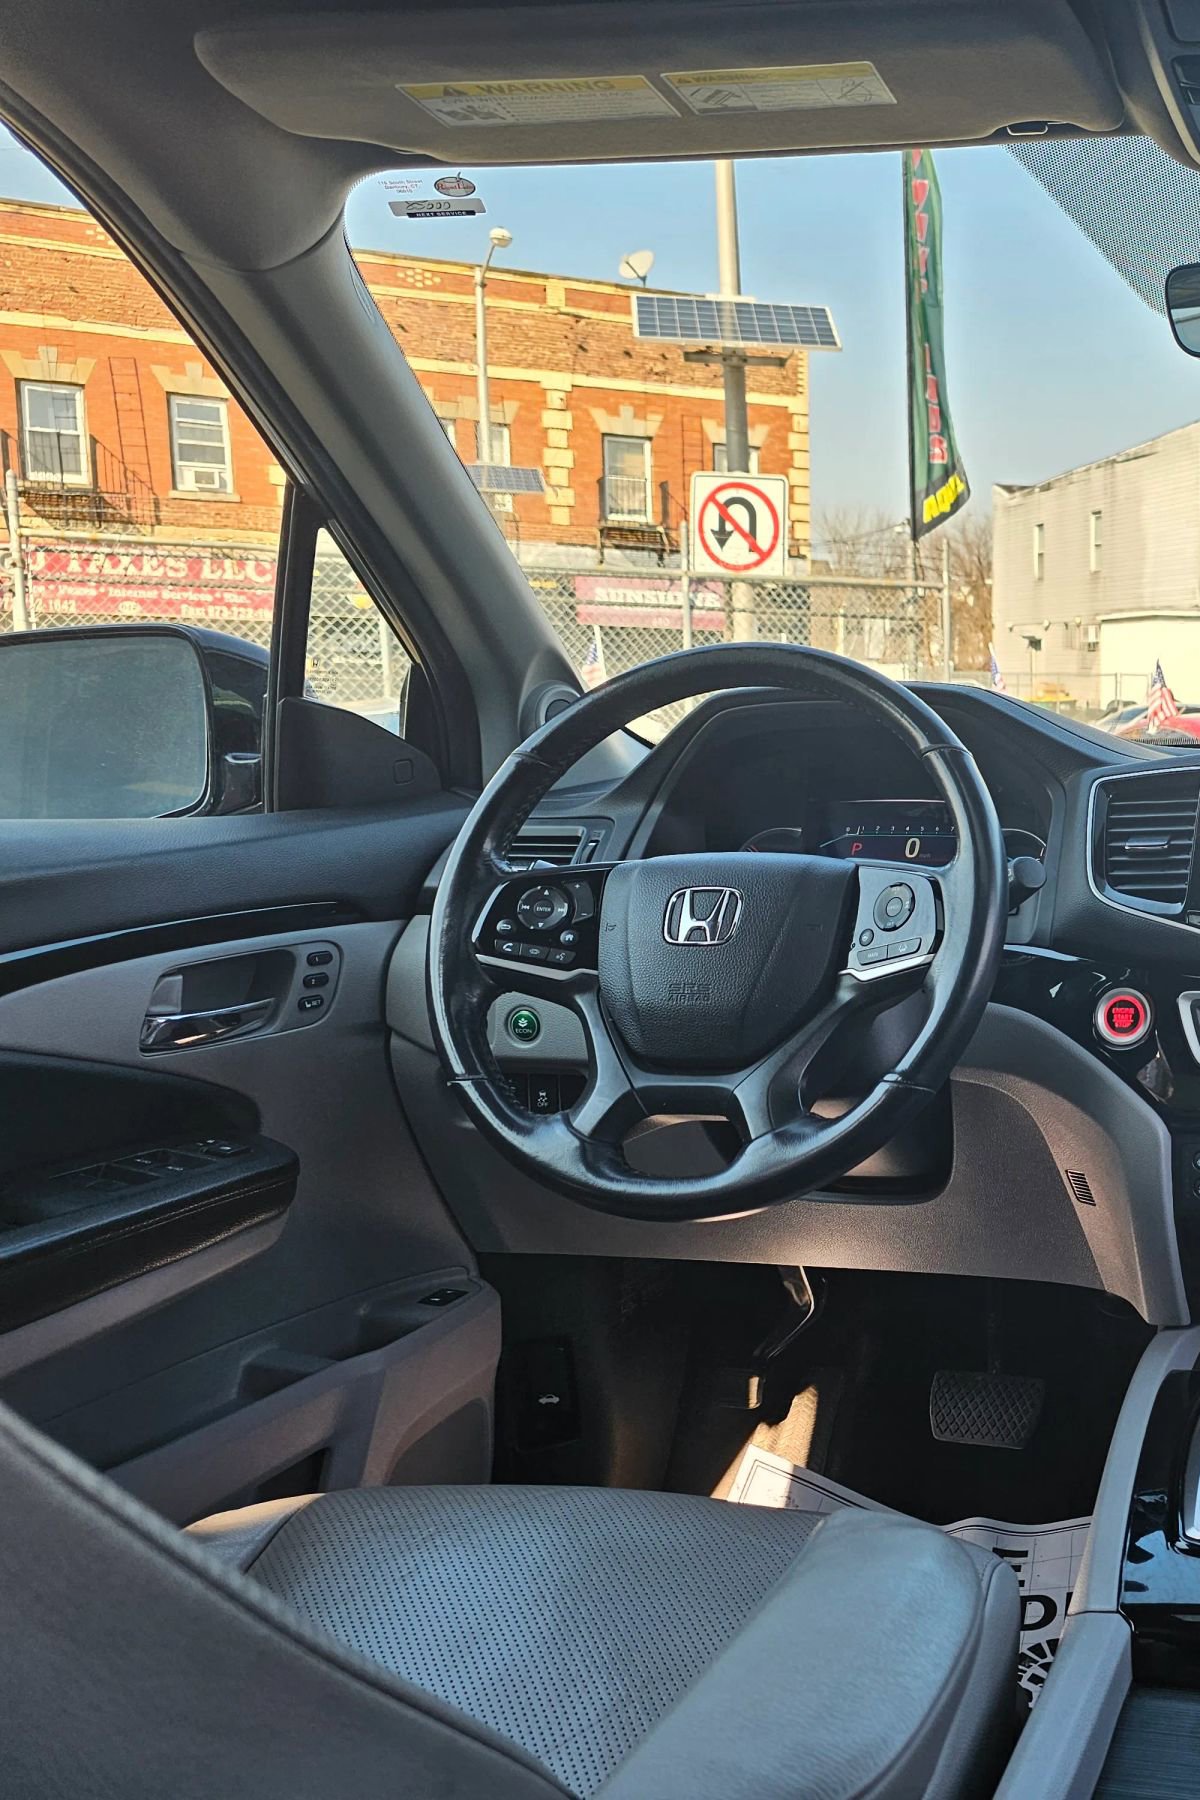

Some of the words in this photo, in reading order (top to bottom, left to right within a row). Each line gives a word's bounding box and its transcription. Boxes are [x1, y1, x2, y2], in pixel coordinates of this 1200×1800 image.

[476, 80, 618, 96] WARNING
[200, 557, 274, 584] LLC
[851, 842, 863, 856] P
[904, 837, 921, 859] 0
